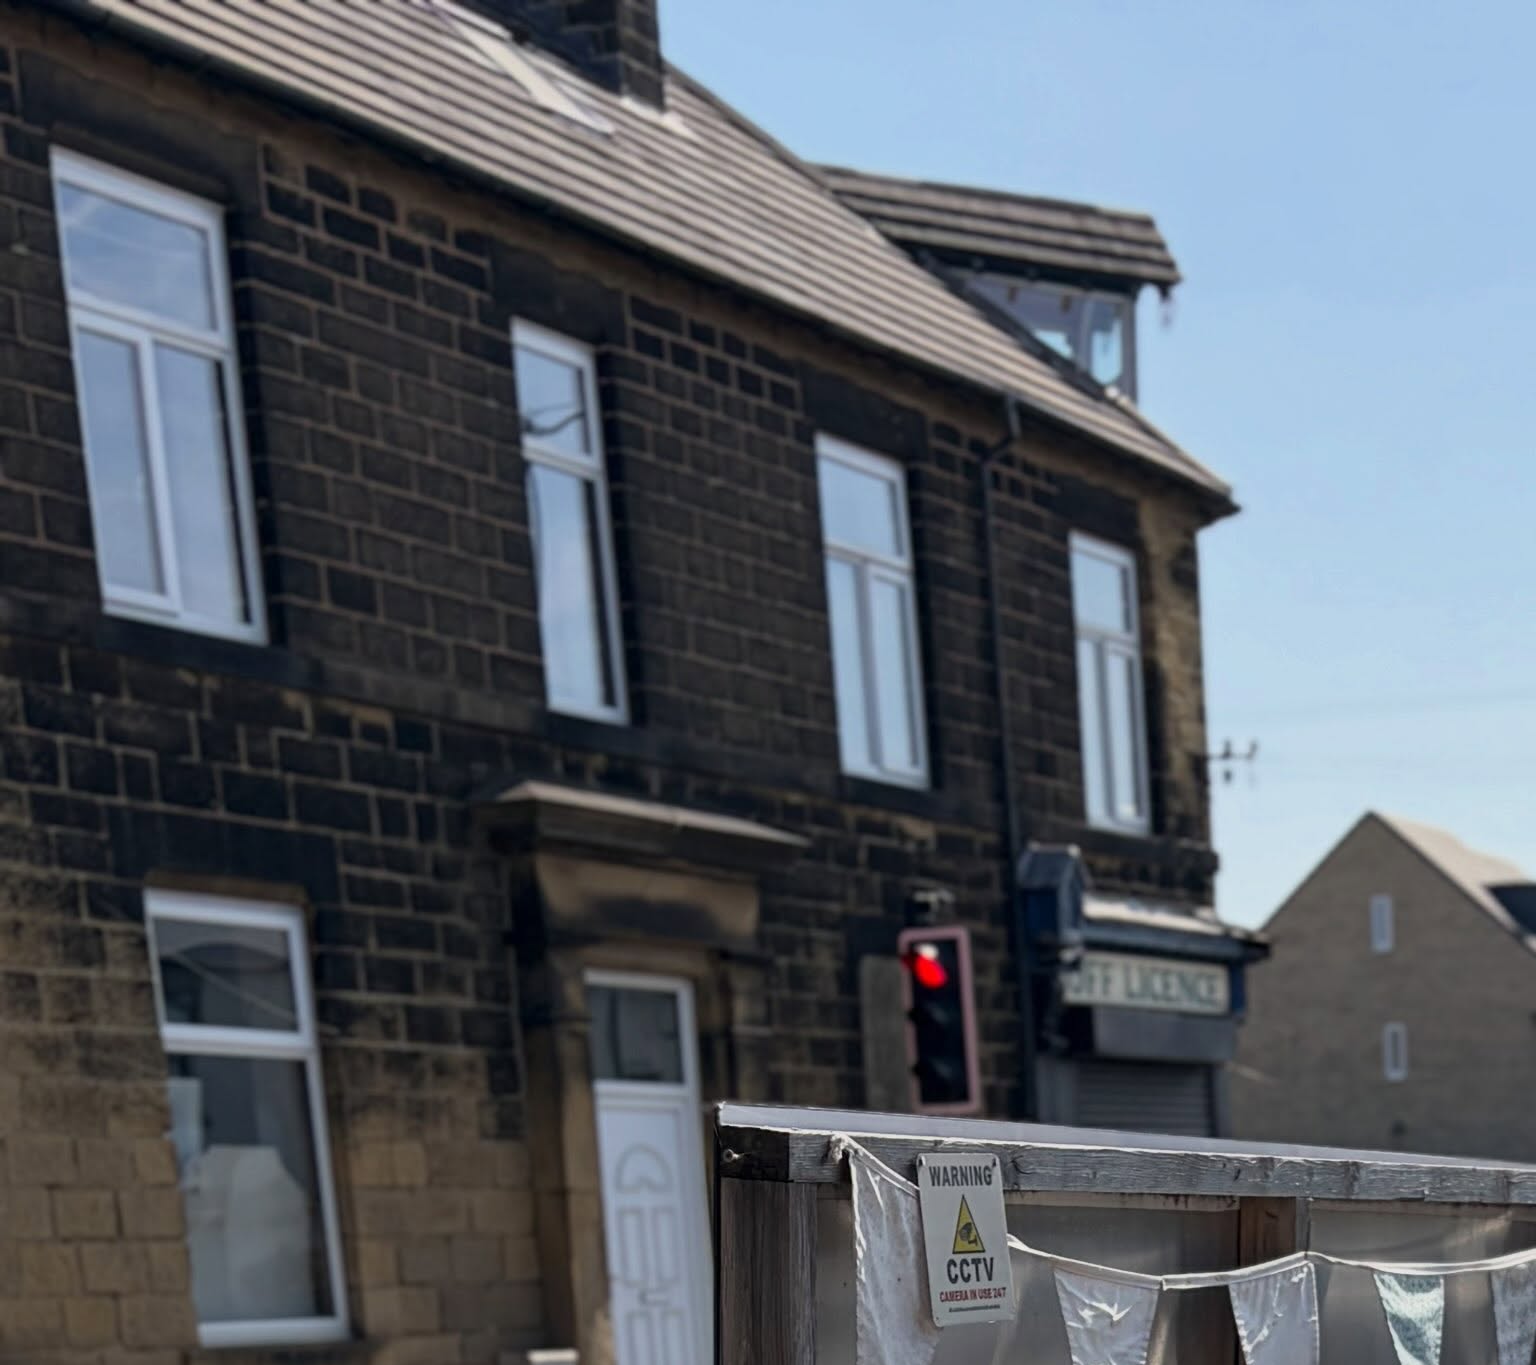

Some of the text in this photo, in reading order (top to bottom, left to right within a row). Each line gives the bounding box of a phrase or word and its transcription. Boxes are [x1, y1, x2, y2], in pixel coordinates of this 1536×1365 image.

[1124, 962, 1219, 1010] LICENCE
[929, 1165, 992, 1187] WARNING
[947, 1257, 994, 1285] CCTV
[940, 1290, 968, 1302] CAMERA
[969, 1289, 977, 1300] IN
[978, 1288, 992, 1300] USE
